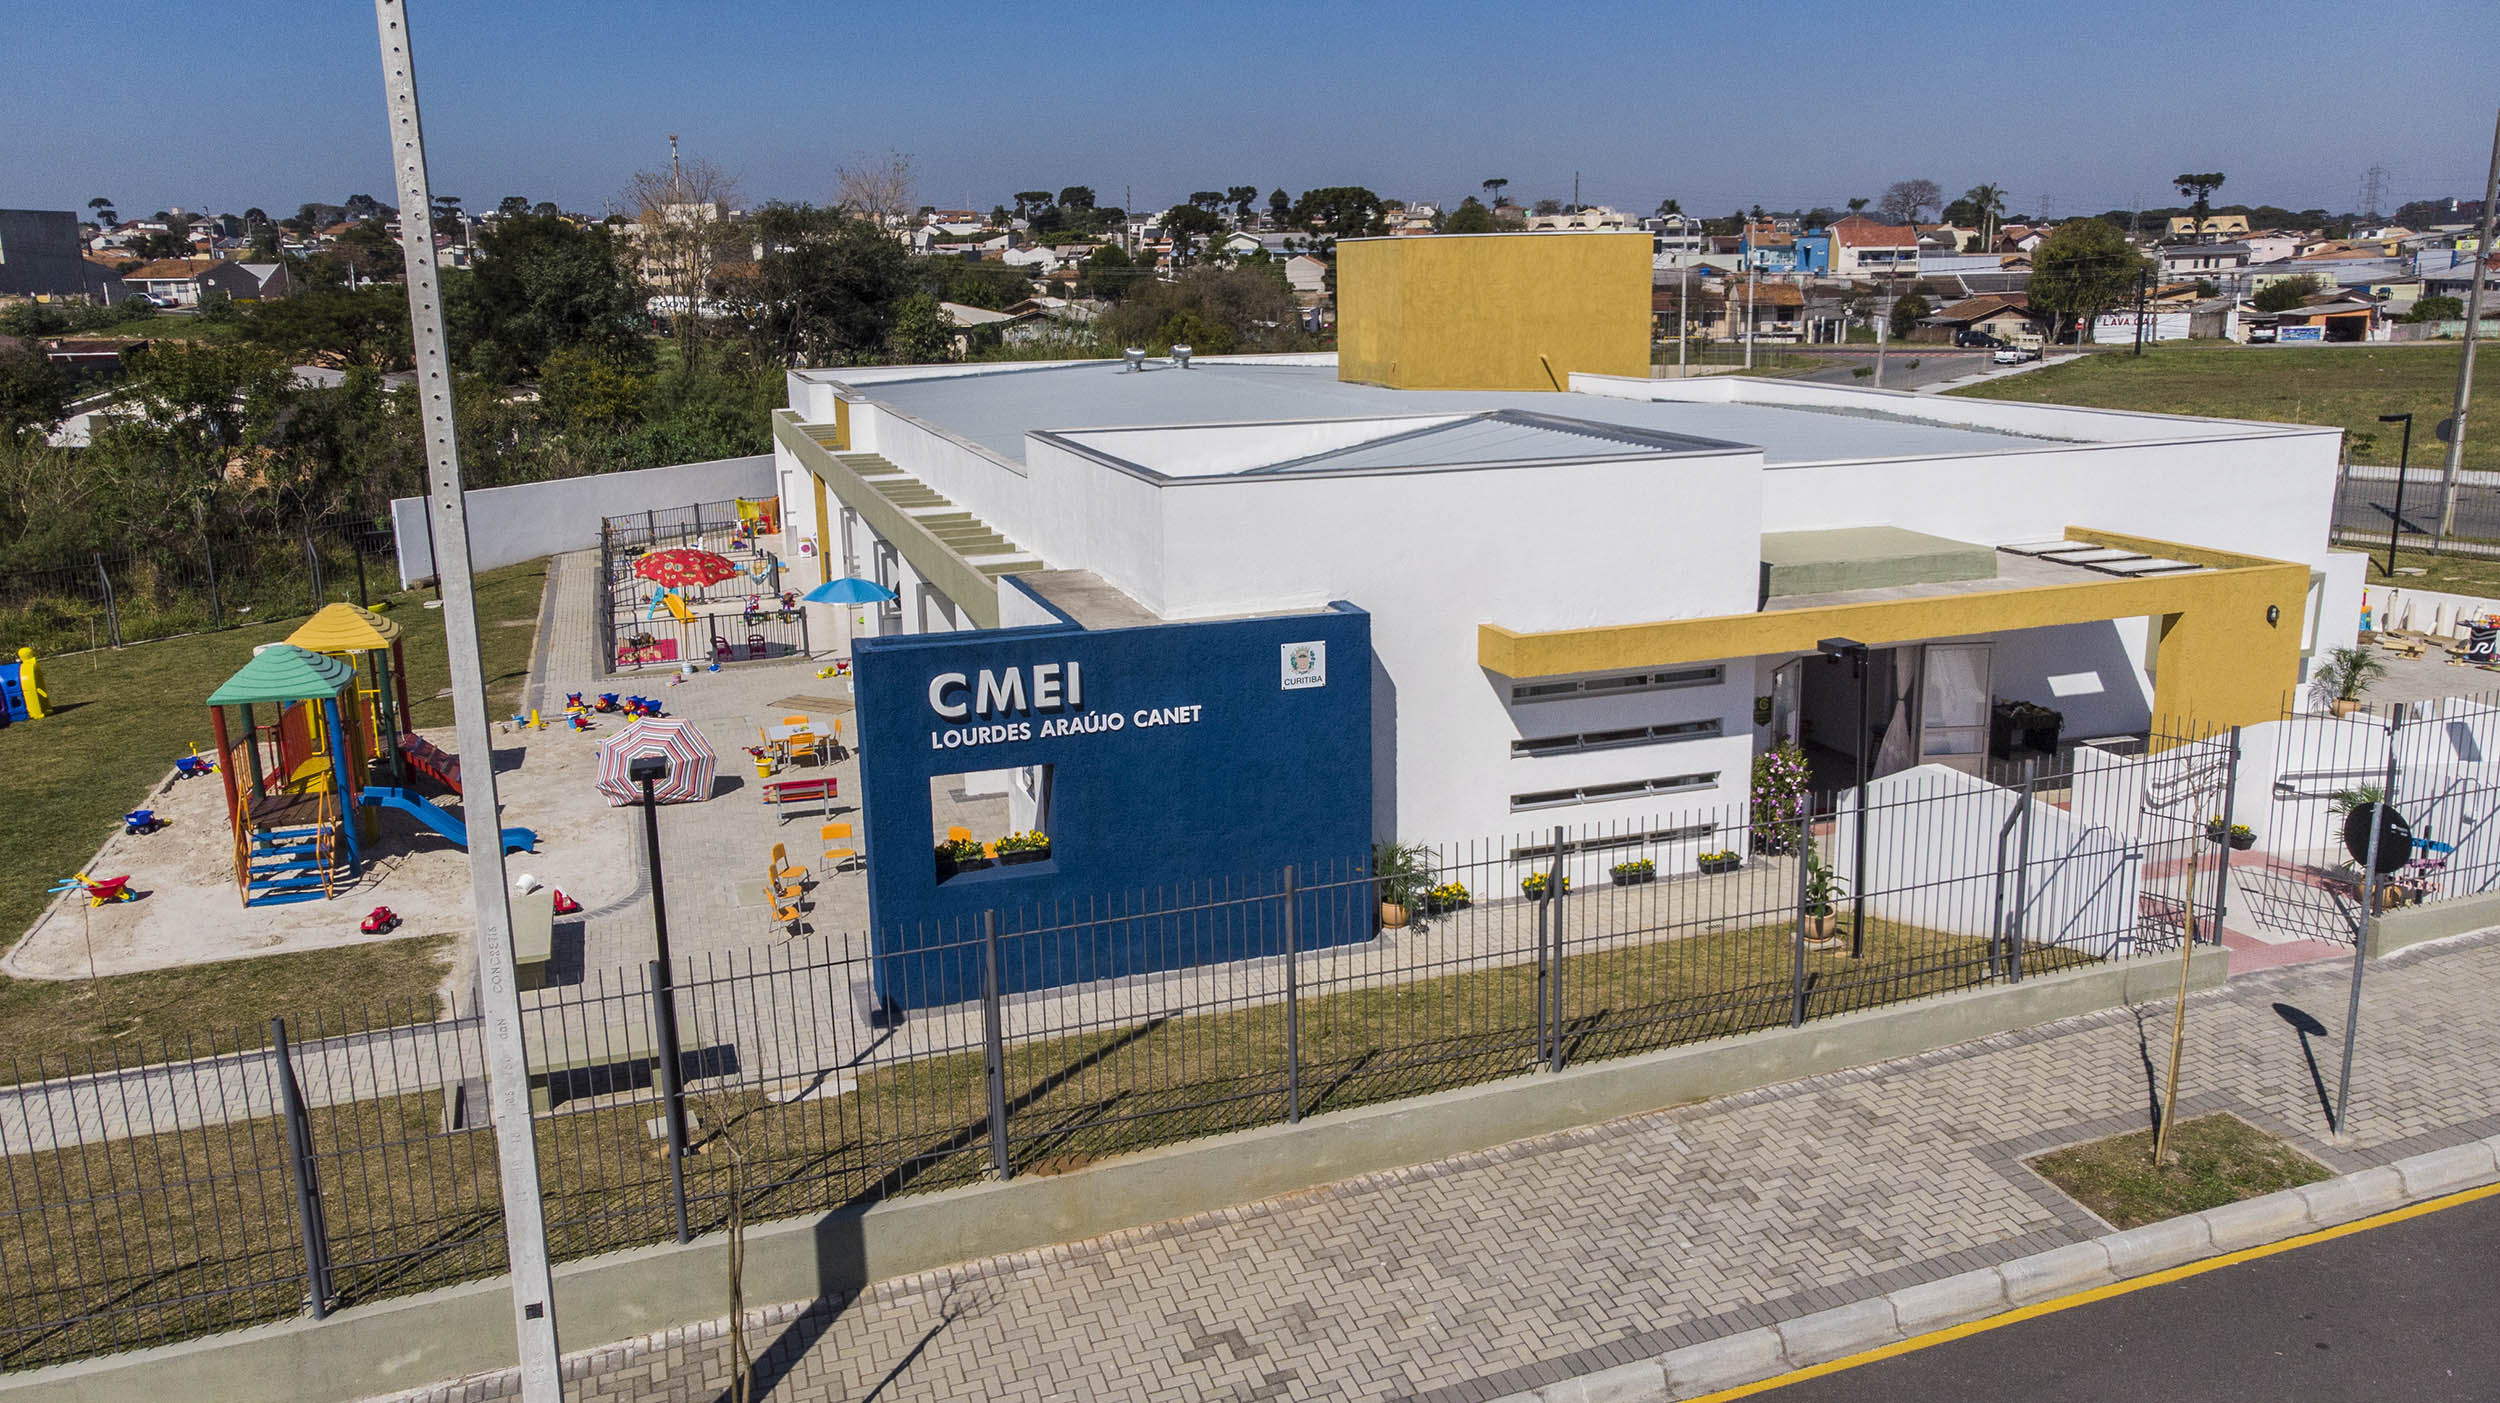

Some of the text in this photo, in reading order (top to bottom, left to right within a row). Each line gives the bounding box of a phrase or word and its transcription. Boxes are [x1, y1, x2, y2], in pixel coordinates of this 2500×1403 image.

[2103, 318, 2129, 327] LAVA
[928, 661, 1081, 717] CMEI
[1284, 675, 1323, 686] CURITIBA
[931, 704, 1202, 749] LOURDES ARAÚJO CANET
